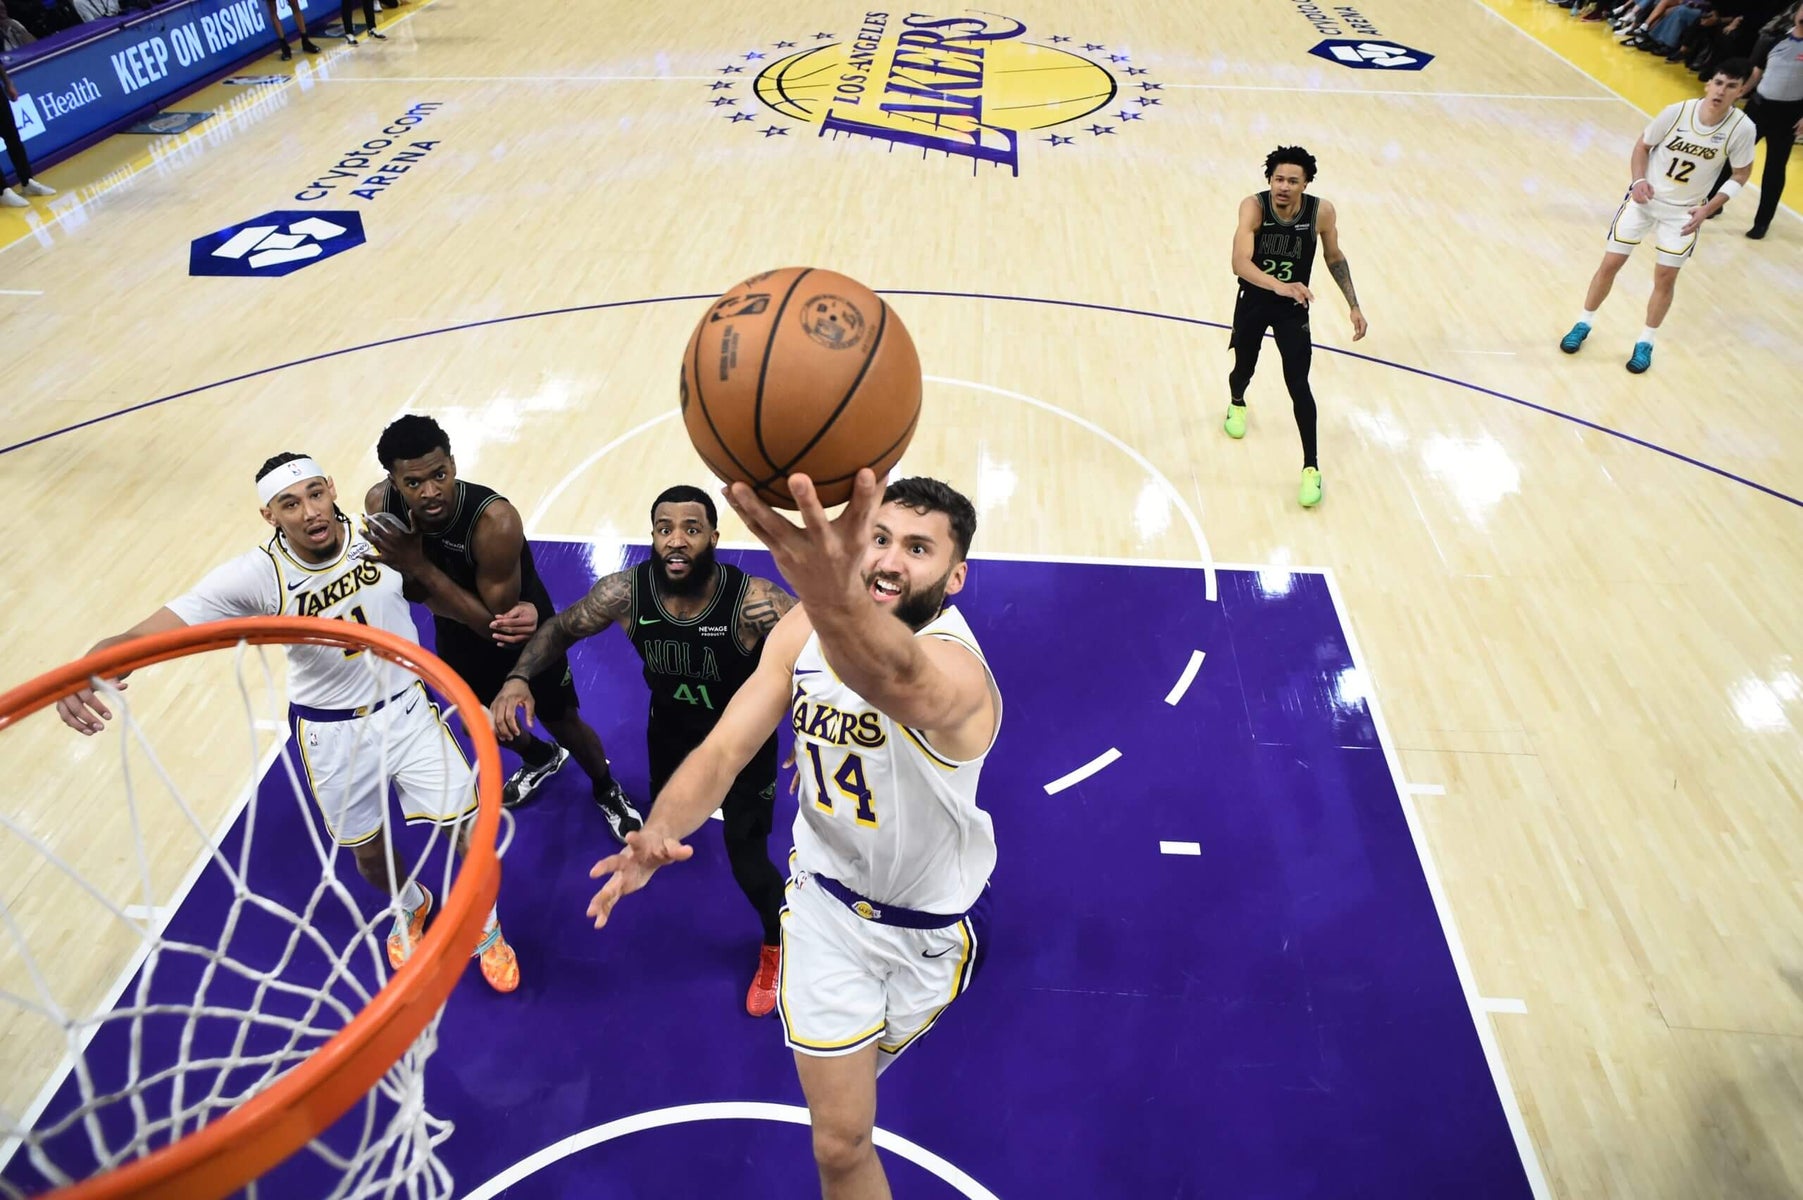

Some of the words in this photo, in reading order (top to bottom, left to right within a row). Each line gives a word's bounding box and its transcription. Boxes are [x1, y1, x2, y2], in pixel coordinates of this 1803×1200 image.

[848, 11, 890, 73] ANGELES
[1333, 7, 1382, 36] ARENA
[111, 37, 168, 94] KEEP
[170, 22, 205, 67] ON
[201, 0, 265, 54] RISING
[37, 76, 102, 121] Health
[818, 9, 1027, 177] LAKERS
[834, 74, 867, 105] LOS
[295, 102, 443, 201] crypto.com
[1665, 135, 1719, 160] LAKERS
[349, 140, 441, 200] ARENA
[1665, 157, 1696, 184] 12
[1260, 233, 1303, 260] NOLA
[1262, 259, 1294, 281] 23
[295, 560, 381, 617] LAKERS
[644, 639, 722, 682] NOLA
[673, 683, 714, 710] 41
[806, 742, 879, 829] 14
